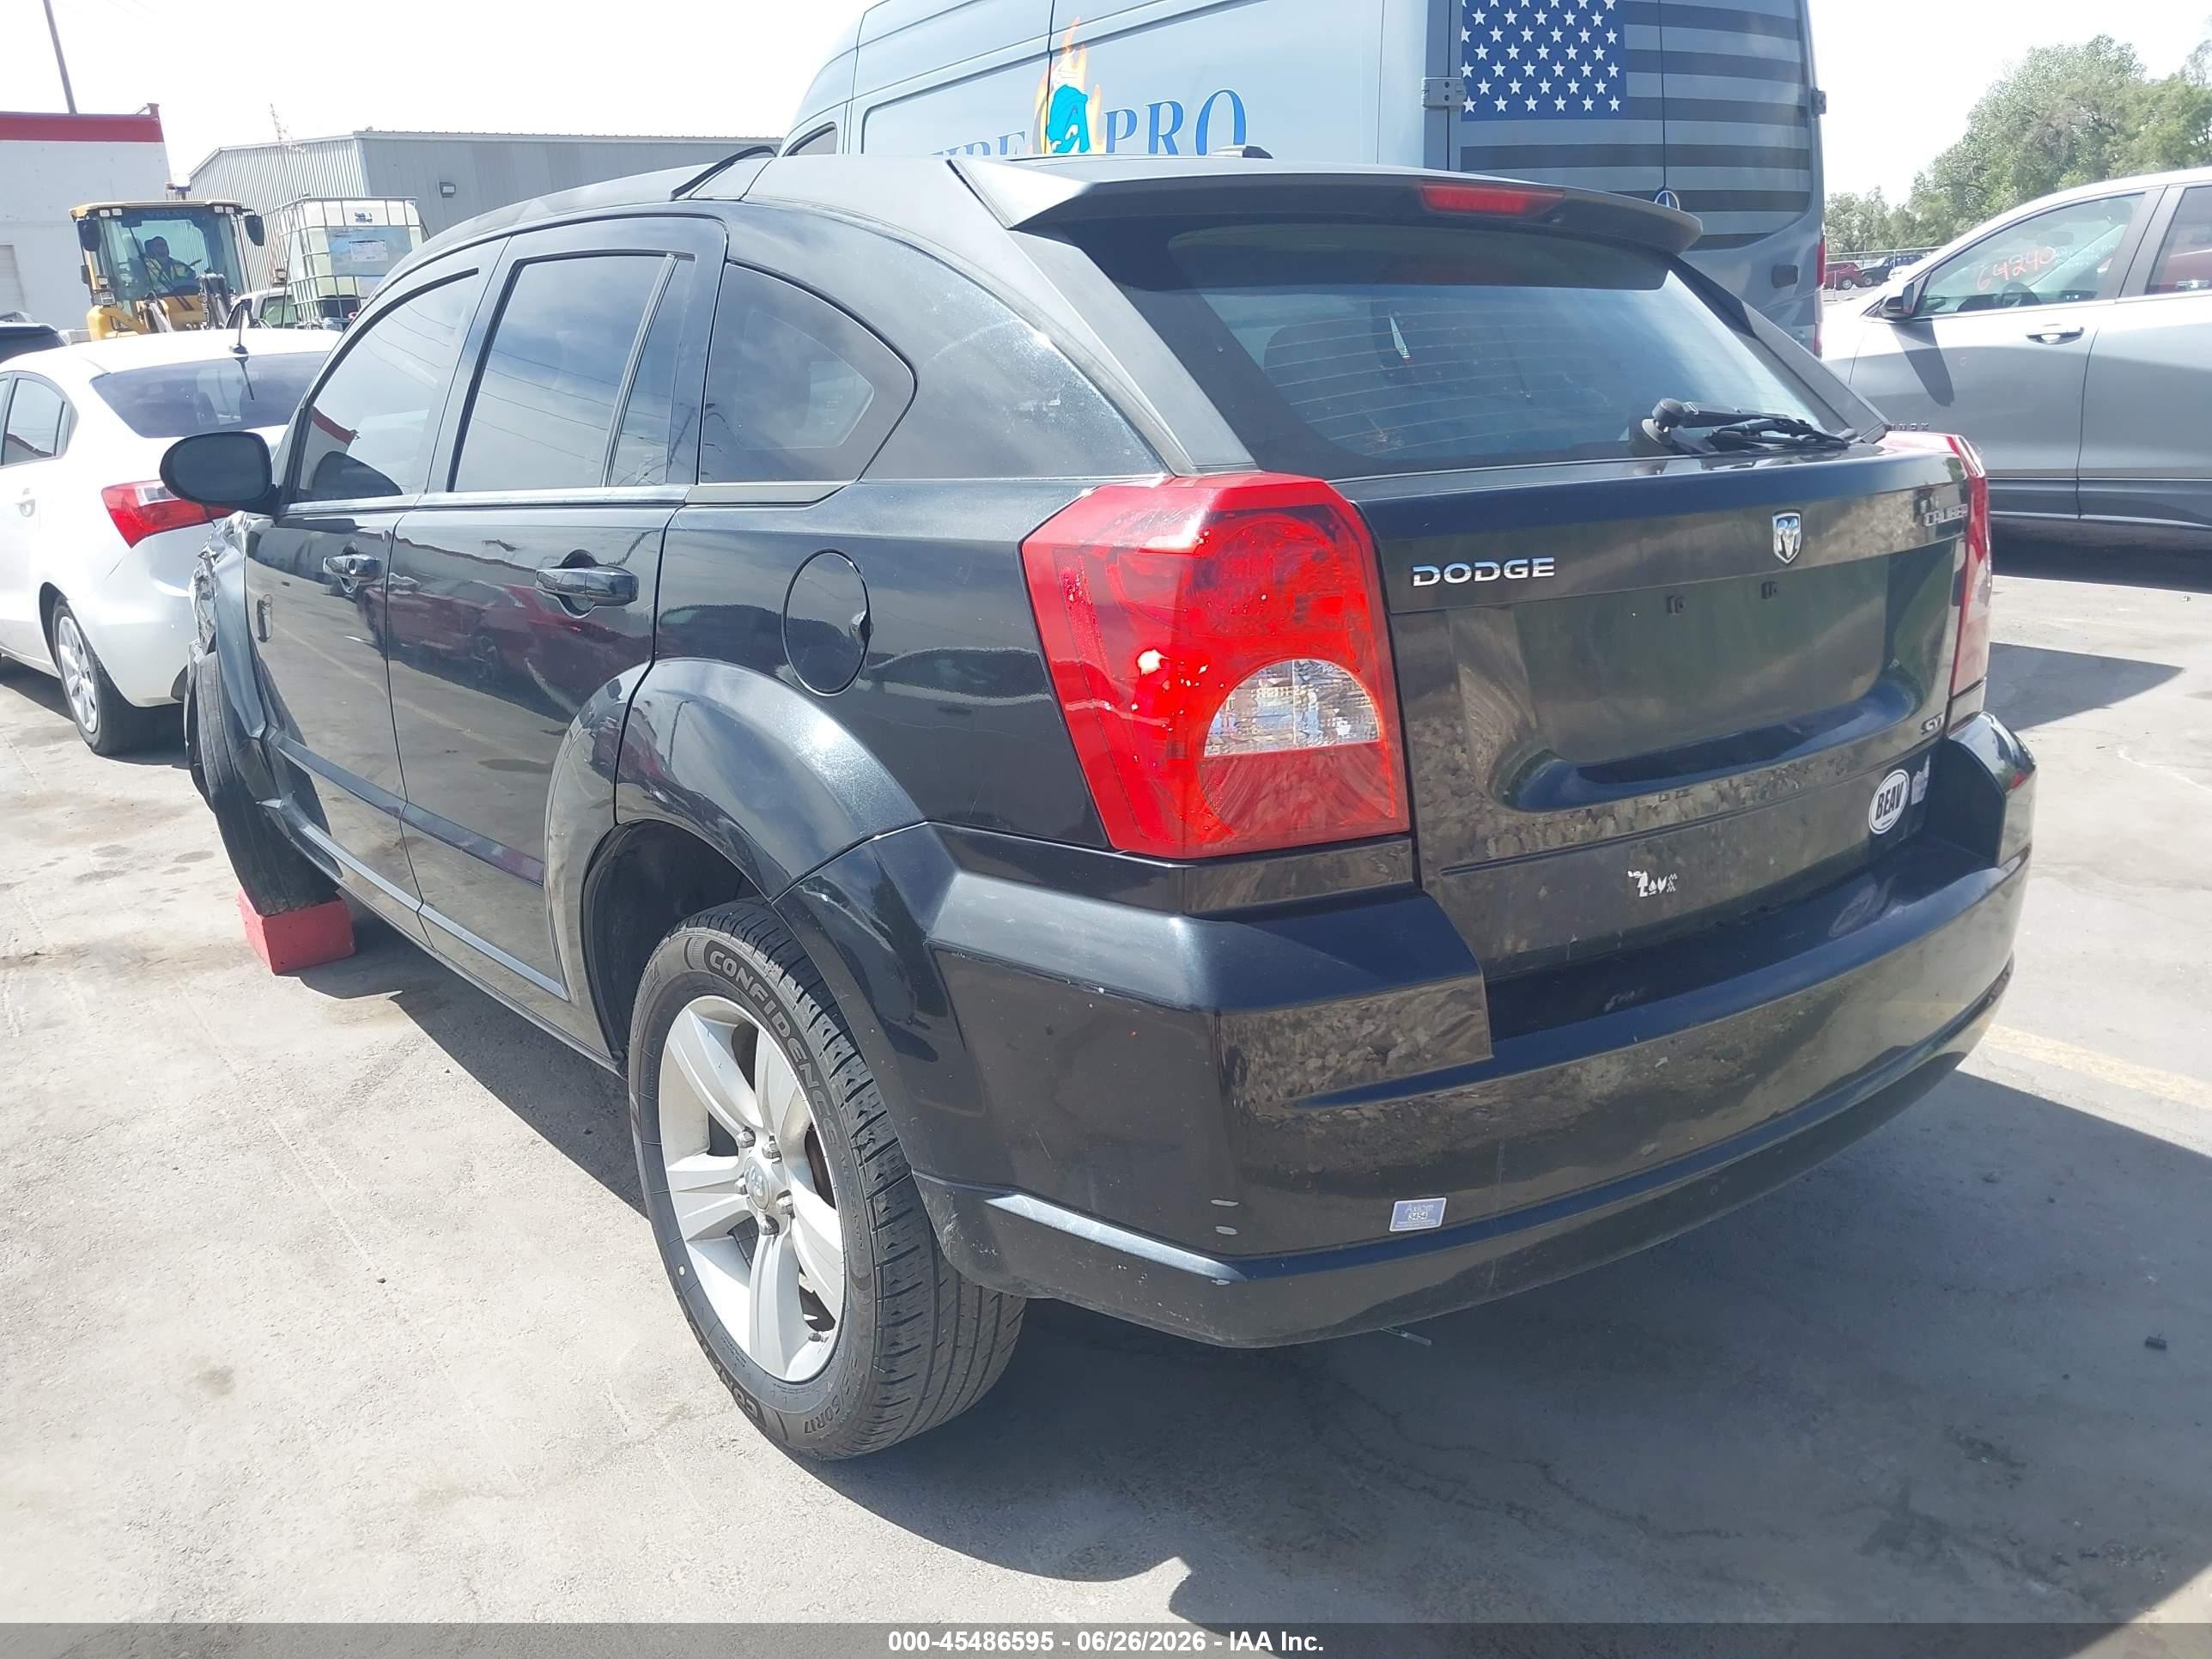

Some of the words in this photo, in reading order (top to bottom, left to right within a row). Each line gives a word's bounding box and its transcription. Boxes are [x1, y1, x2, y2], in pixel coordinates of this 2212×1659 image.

[1103, 89, 1245, 155] PRO
[1413, 557, 1554, 586] DODGE
[1875, 781, 1905, 821] BEAV
[709, 950, 838, 1146] CONFIDENCE
